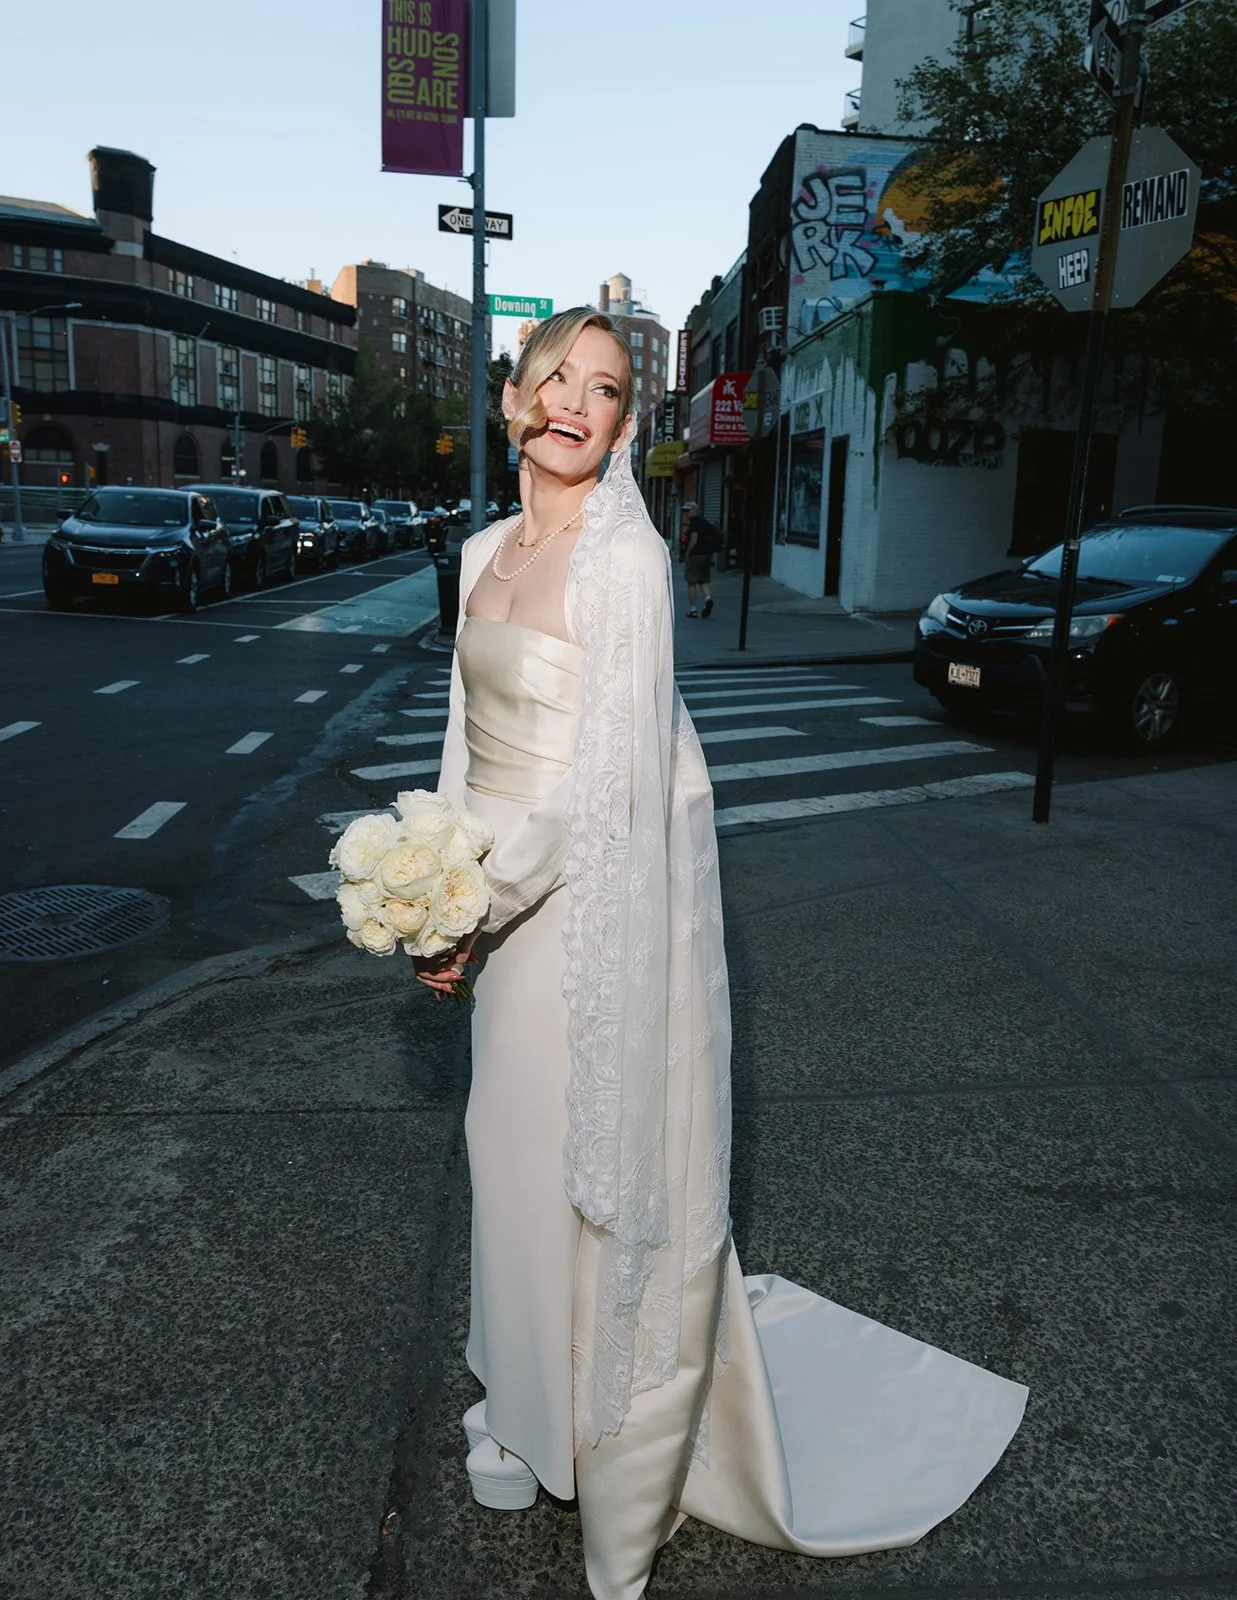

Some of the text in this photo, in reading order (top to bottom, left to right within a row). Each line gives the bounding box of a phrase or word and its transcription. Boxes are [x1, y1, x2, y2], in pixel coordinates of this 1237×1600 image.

[388, 0, 432, 26] THIS IS
[1122, 171, 1189, 230] REMAND
[449, 214, 471, 227] ONE
[1058, 249, 1089, 289] HEEP
[494, 296, 547, 318] Downing St
[714, 400, 732, 412] 222
[665, 405, 676, 434] BELL
